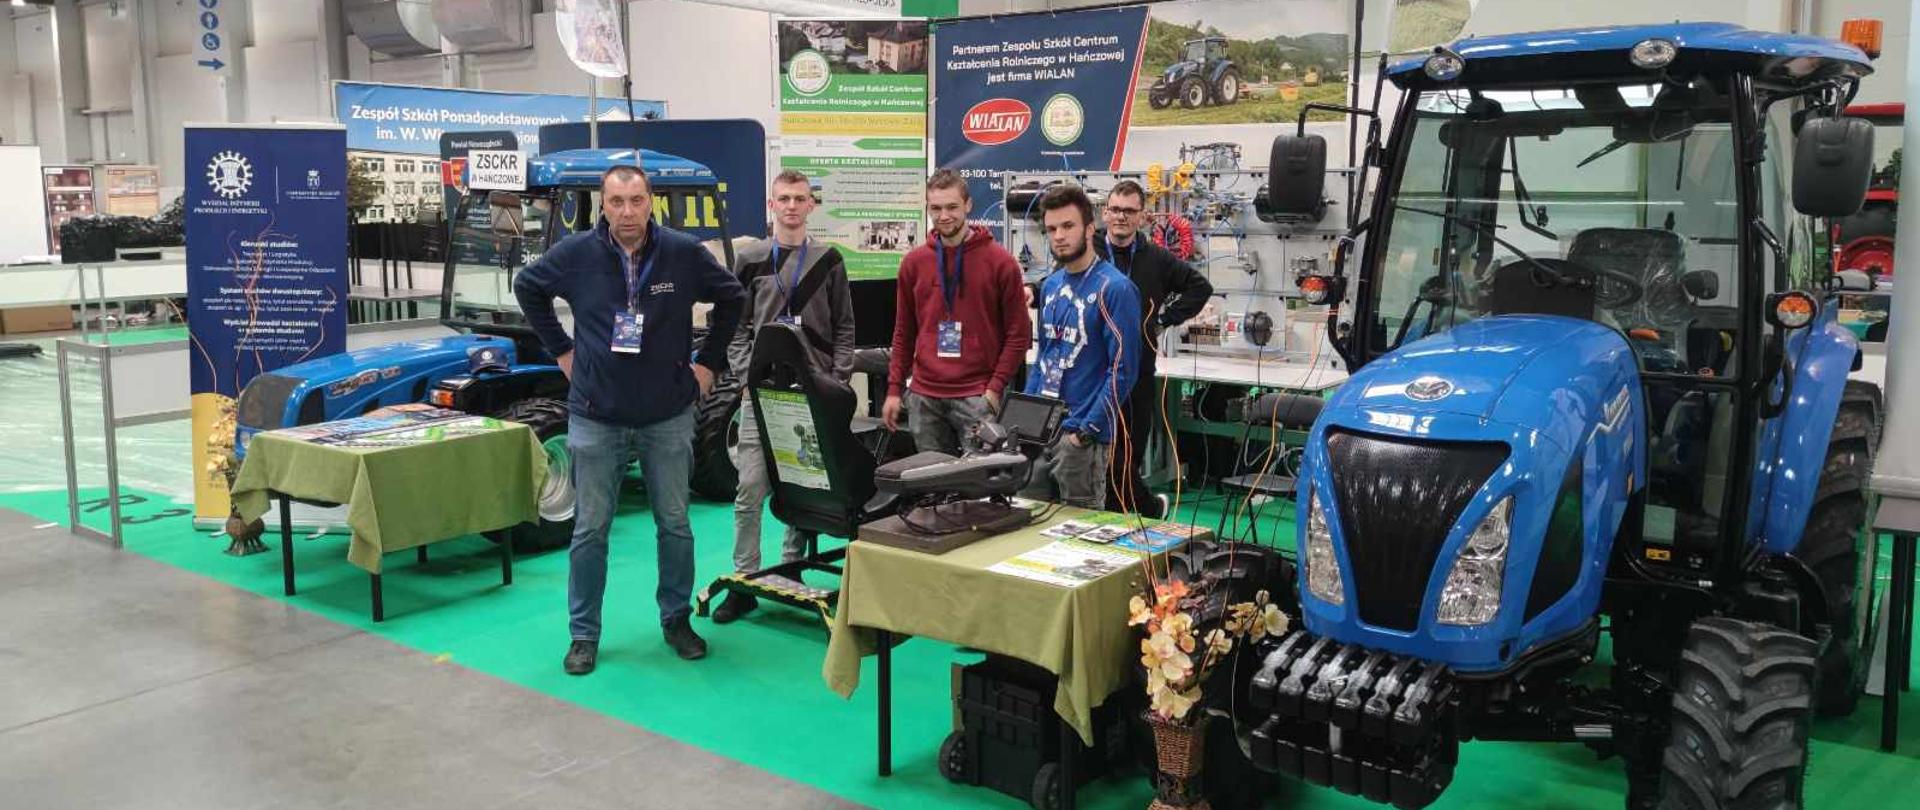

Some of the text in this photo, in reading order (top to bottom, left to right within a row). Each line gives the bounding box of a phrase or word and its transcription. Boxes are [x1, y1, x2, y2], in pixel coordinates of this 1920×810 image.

[952, 34, 1119, 56] Partnerem Zespołu Szkół Centrum
[946, 49, 1125, 70] Kształcenia Rolniczego w Hańczowej
[986, 68, 1075, 85] jest firma WIALAN
[889, 85, 924, 93] Centrum
[829, 98, 872, 107] Rolniczego
[351, 104, 399, 121] Zespół
[402, 107, 438, 122] Szkół
[968, 111, 1025, 132] WIALAN
[376, 127, 397, 141] im.
[399, 127, 420, 141] W.
[476, 153, 518, 170] ZSCKR
[960, 169, 987, 178] 33-100
